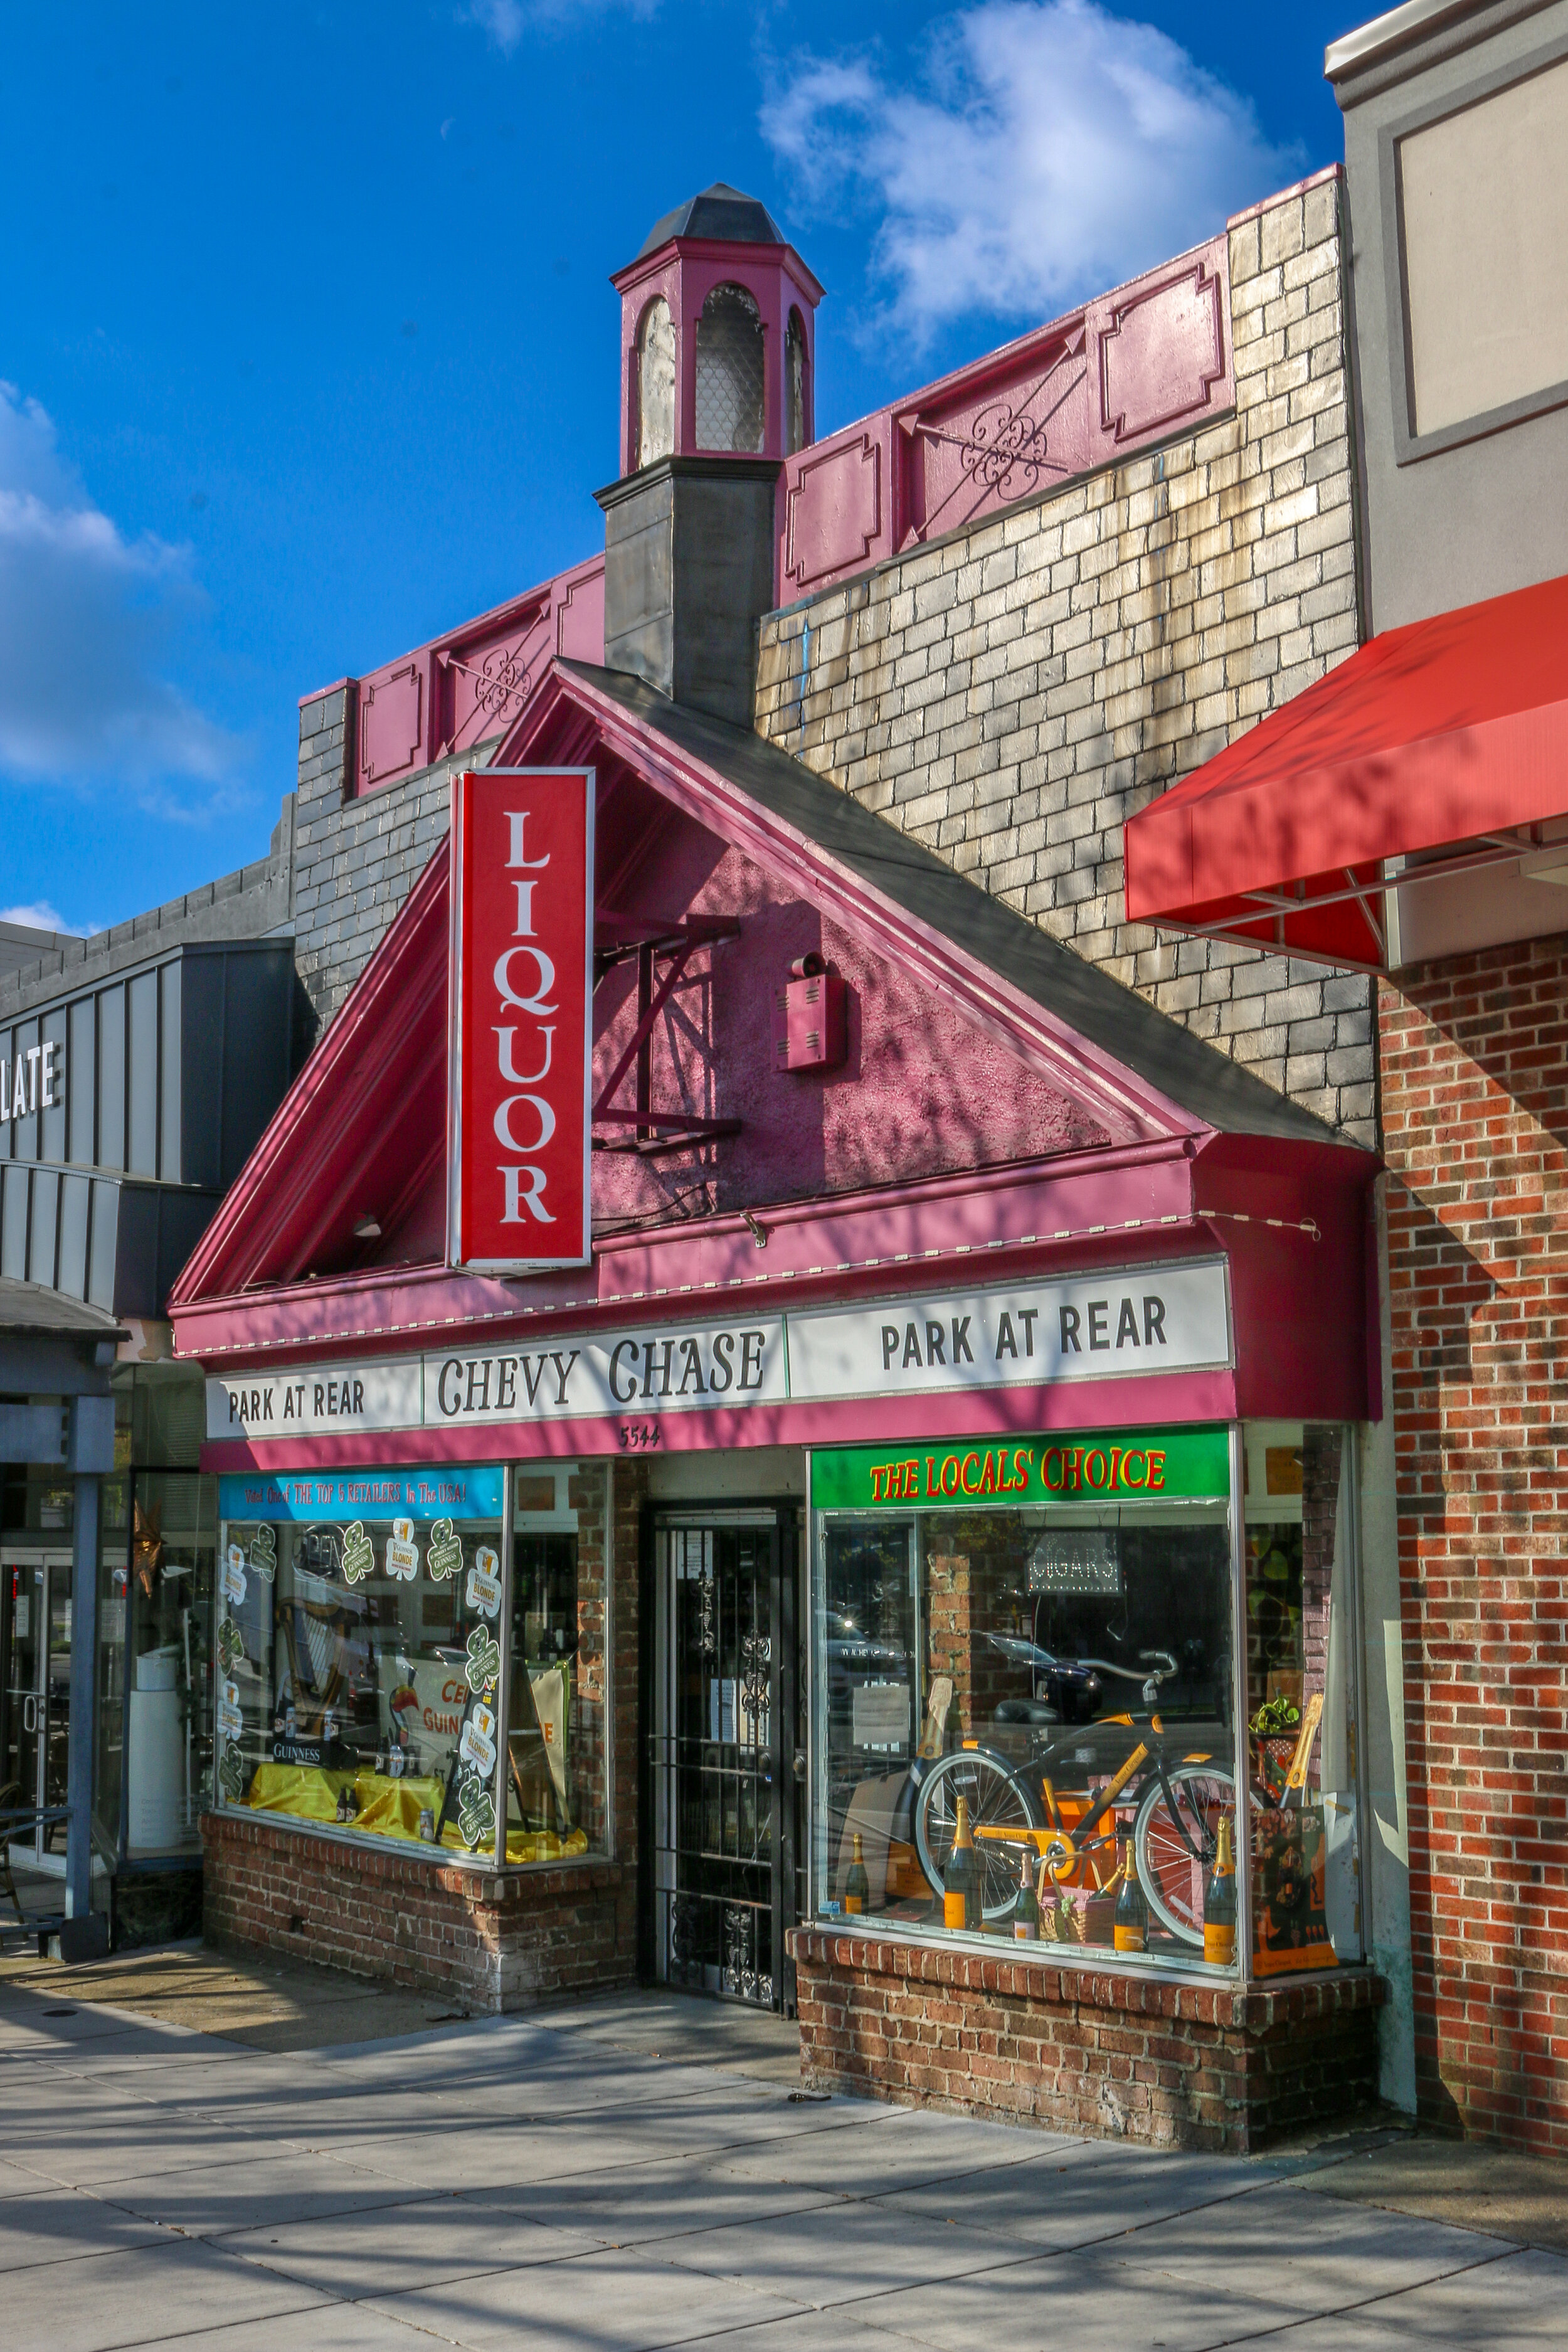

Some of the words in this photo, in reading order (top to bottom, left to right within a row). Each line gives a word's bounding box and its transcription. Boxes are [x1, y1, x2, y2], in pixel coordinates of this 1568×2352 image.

[490, 811, 559, 1224] LIQUOR
[0, 1041, 55, 1121] LATE
[881, 1316, 974, 1370] PARK
[995, 1308, 1038, 1360] AT
[1059, 1295, 1167, 1354] REAR
[438, 1350, 581, 1417] CHEVY
[608, 1330, 766, 1404] CHASE
[229, 1388, 274, 1423] PARK
[283, 1384, 306, 1419] AT
[314, 1380, 364, 1416] REAR
[619, 1425, 660, 1447] 5544
[870, 1459, 919, 1502] THE
[925, 1448, 1034, 1498] LOCALS'
[1040, 1446, 1167, 1491] CHOICE
[267, 1486, 282, 1503] One
[282, 1486, 290, 1503] of
[294, 1483, 313, 1504] THE
[316, 1484, 334, 1504] TOP
[338, 1483, 344, 1503] 5
[347, 1483, 401, 1503] RETAILERS
[406, 1483, 416, 1503] In
[418, 1483, 436, 1503] The
[348, 1554, 369, 1572] GUINNESS
[392, 1552, 413, 1566] BLONDE
[434, 1552, 457, 1569] GUINNESS
[1032, 1546, 1113, 1579] CIGARS
[473, 1582, 495, 1602] BLONDE
[474, 1659, 495, 1681] GUINNESS
[273, 1742, 320, 1761] GUINNESS
[468, 1735, 489, 1762] BLONDE
[467, 1810, 489, 1833] GUINNESS
